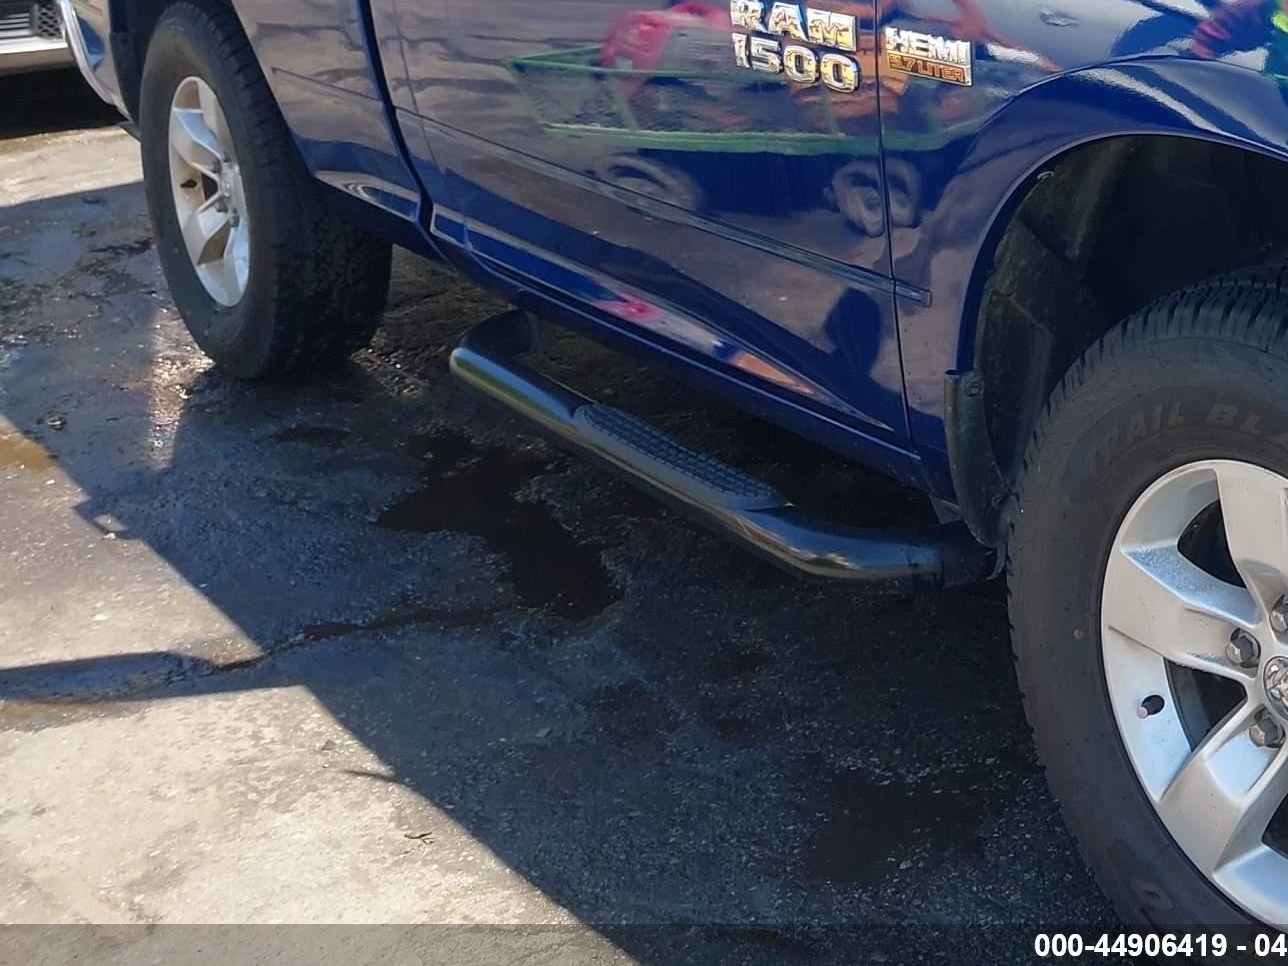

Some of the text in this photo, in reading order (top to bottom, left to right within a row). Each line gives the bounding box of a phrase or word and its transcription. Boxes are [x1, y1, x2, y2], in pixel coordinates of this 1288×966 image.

[732, 32, 861, 93] 1500
[885, 27, 971, 65] HEMI
[889, 54, 965, 83] 5.7 LITER
